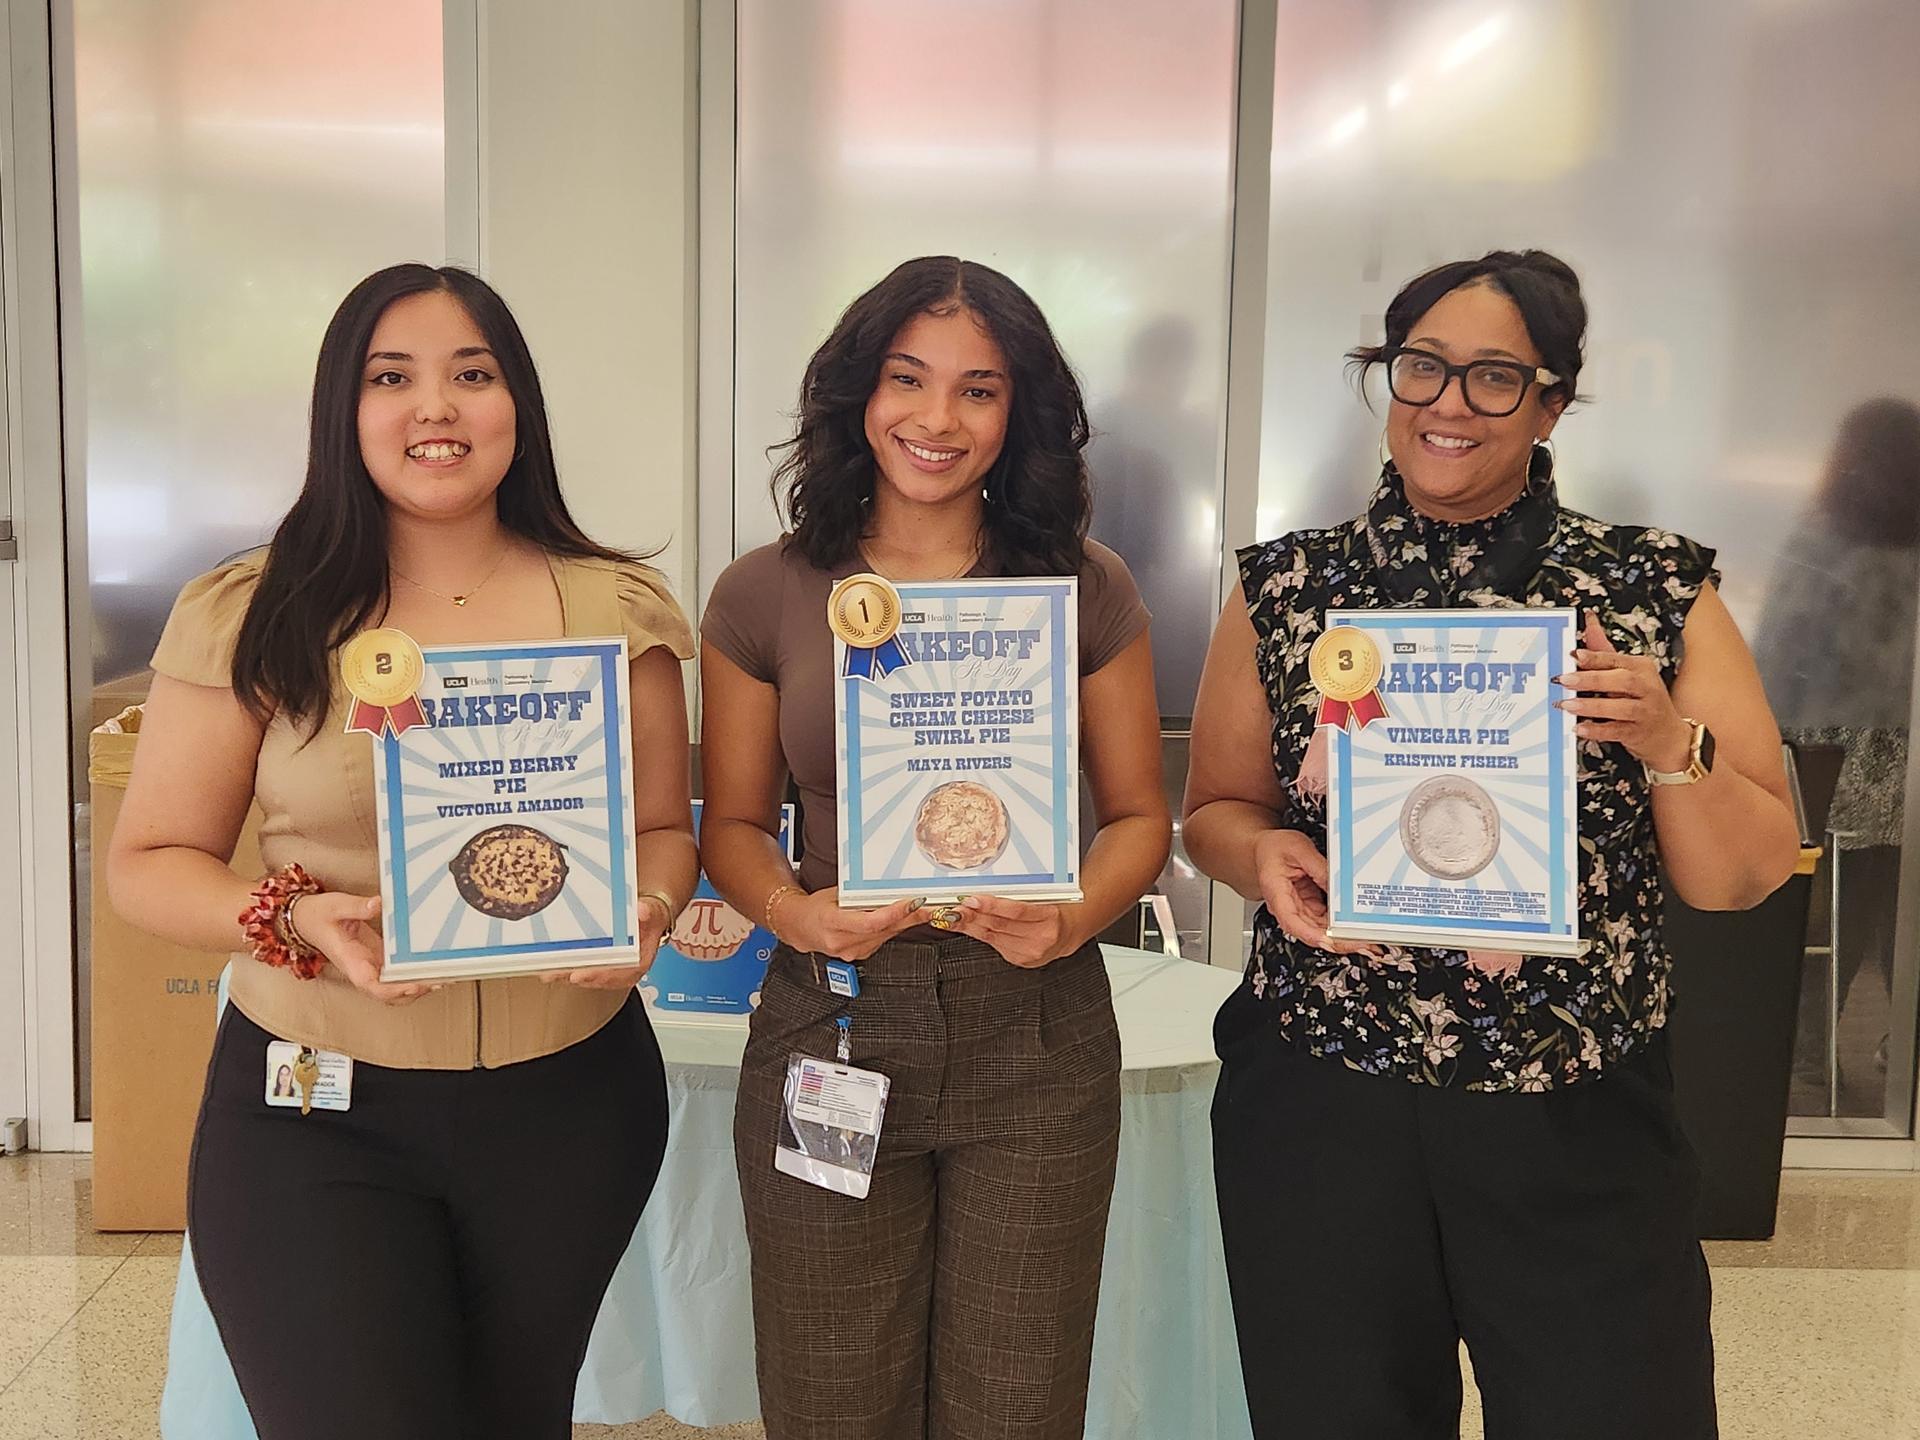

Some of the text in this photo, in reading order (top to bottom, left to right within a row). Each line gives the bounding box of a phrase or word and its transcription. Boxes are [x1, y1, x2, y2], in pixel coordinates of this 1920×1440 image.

[857, 598, 870, 623] 1
[903, 613, 953, 623] UCLA Health
[899, 629, 1040, 661] AKEOFF
[1395, 643, 1445, 653] UCLA Health
[375, 653, 392, 675] 2
[1338, 650, 1353, 670] 3
[445, 677, 498, 687] UCLA Health
[984, 659, 1022, 686] Day
[1377, 663, 1536, 694] AKEOFF
[890, 690, 1033, 709] SWEET POTATO
[889, 708, 1034, 728] CREAM CHEESE
[914, 728, 1010, 745] SWIRL PIE
[1387, 727, 1509, 745] VINEGAR PIE
[438, 755, 578, 778] MIXED BERRY
[907, 756, 1012, 771] MAYA RIVERS
[1384, 753, 1519, 769] KRISTINE FISHER
[493, 777, 526, 794] PIE
[437, 797, 584, 818] VICTORIA AMADOR
[166, 978, 200, 994] UCLA
